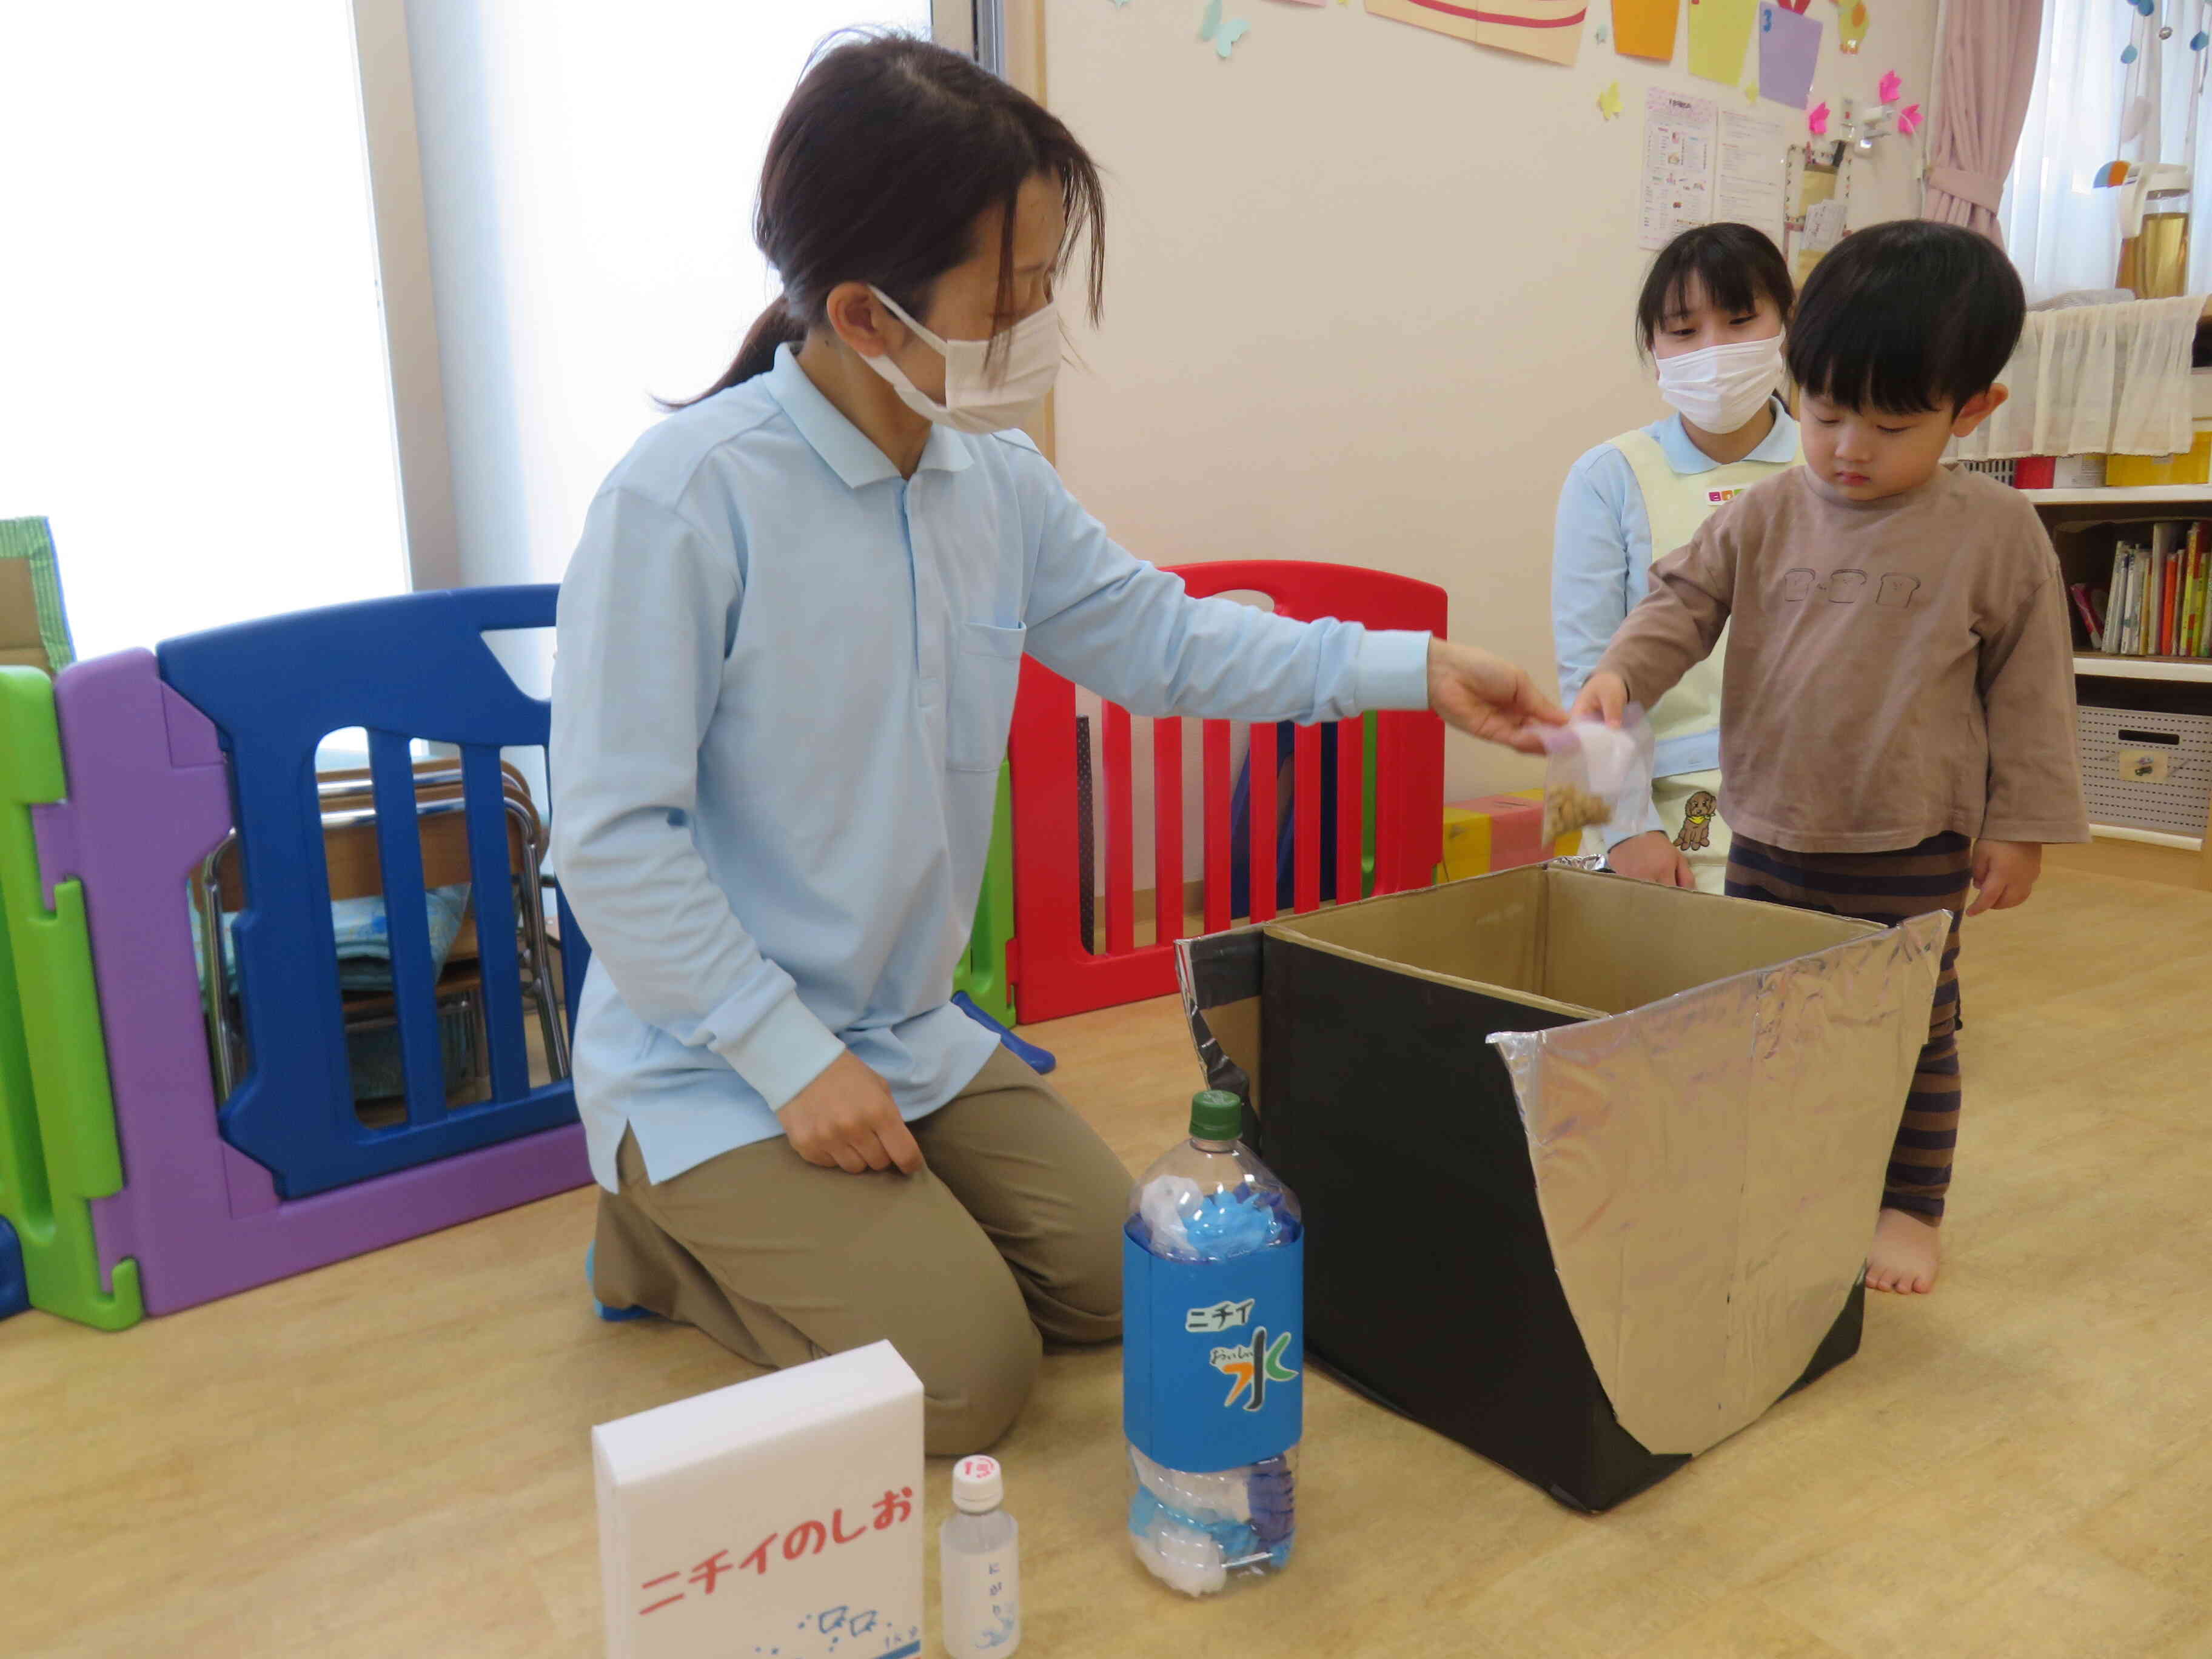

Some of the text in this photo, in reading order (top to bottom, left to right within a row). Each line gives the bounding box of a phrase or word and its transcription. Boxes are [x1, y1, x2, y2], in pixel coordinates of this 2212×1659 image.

[1188, 1300, 1255, 1330] ニチイ
[1222, 1329, 1299, 1410] 水
[639, 1486, 913, 1615] ニチイのしお
